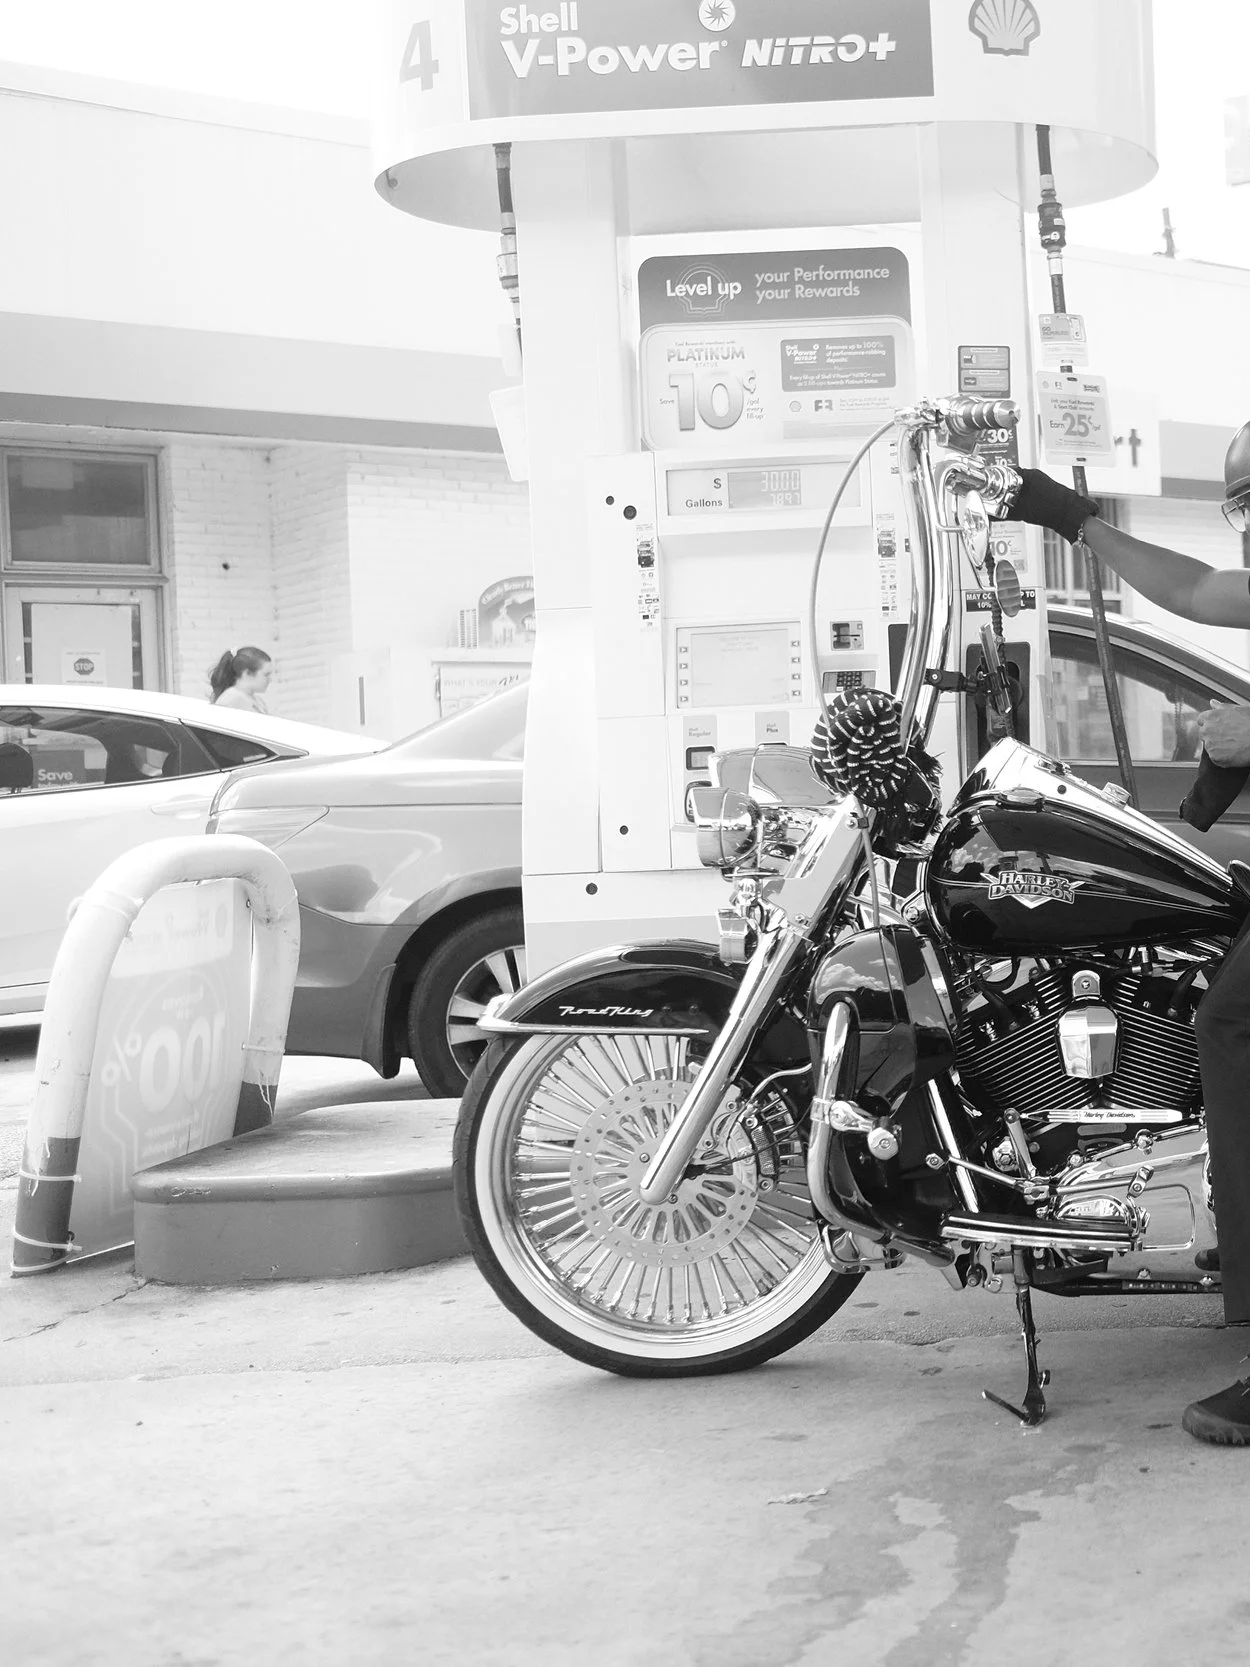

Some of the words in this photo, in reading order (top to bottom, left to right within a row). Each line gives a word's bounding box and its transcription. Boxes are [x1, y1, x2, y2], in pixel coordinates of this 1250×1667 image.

[499, 1, 579, 35] Shell
[400, 19, 440, 92] 4
[500, 37, 722, 79] V-Power
[754, 270, 790, 288] your
[793, 264, 890, 283] Performance
[666, 275, 712, 298] Level
[717, 279, 742, 301] up
[755, 288, 791, 304] your
[795, 282, 861, 299] Rewards
[863, 341, 884, 349] 100%
[666, 346, 746, 363] PLATINUM
[1049, 420, 1065, 429] Earn
[685, 497, 723, 509] Gallons
[966, 593, 981, 601] MAY
[1025, 590, 1036, 598] TO
[977, 601, 992, 609] 10%
[74, 662, 94, 672] STOP
[38, 768, 73, 781] Save
[990, 883, 1074, 903] DAVIDSON
